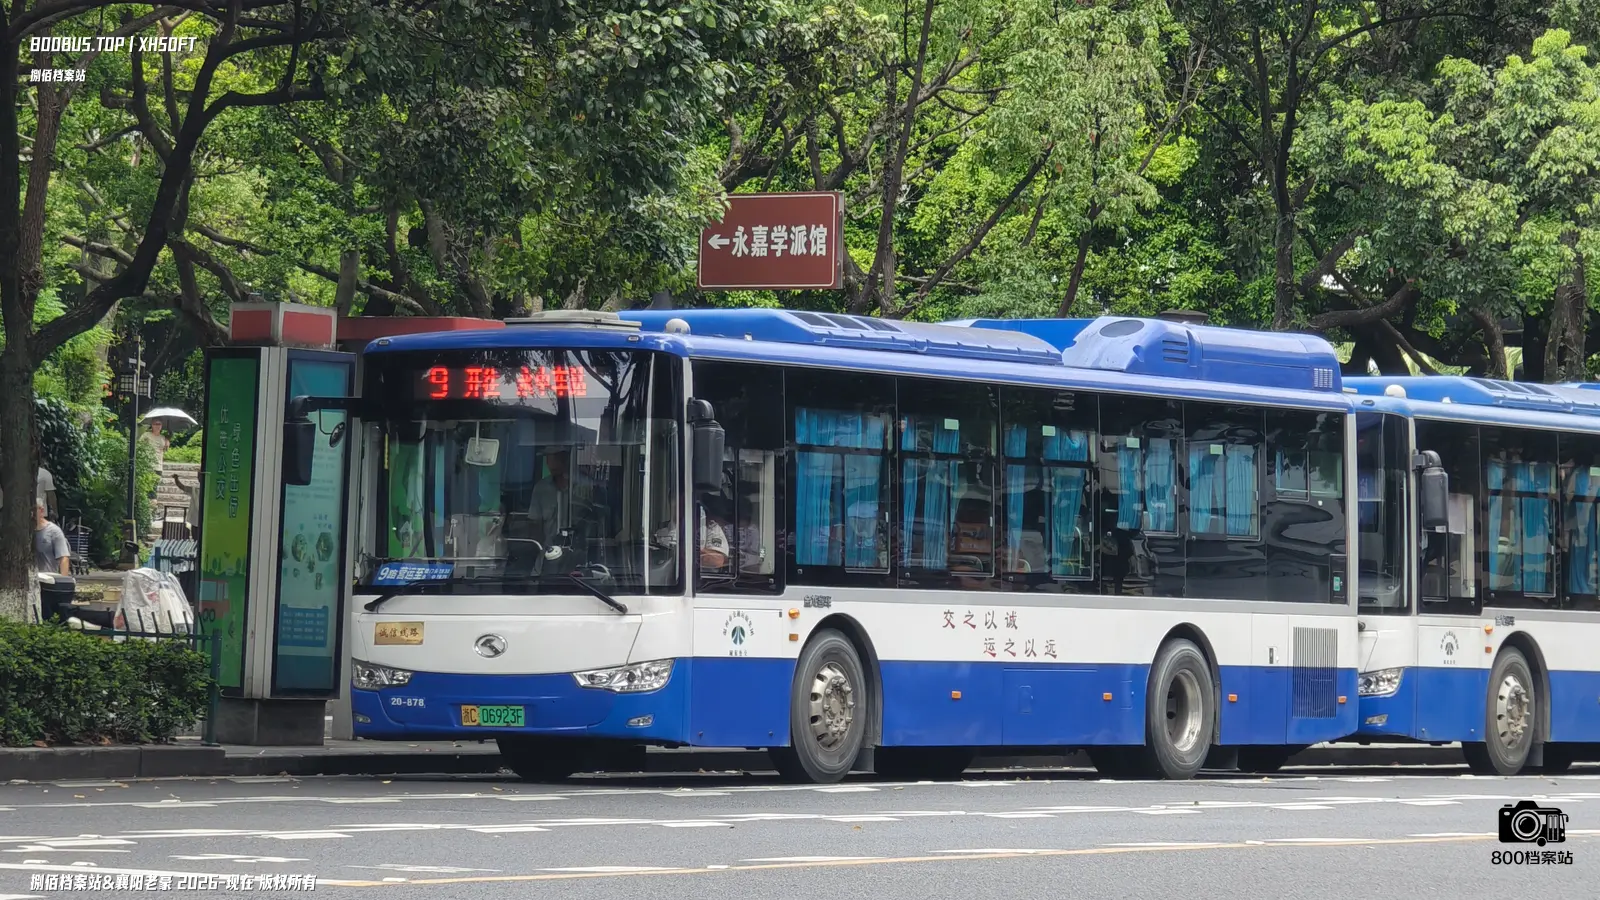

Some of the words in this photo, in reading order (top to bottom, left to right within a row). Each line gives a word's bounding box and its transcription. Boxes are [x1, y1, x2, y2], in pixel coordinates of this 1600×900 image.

[731, 223, 828, 258] 永嘉学派馆
[429, 365, 449, 398] 9
[942, 609, 1018, 630] 交之以诚
[379, 627, 420, 639] 诚信线路
[983, 637, 1058, 659] 运之以远
[391, 697, 425, 708] 20-878
